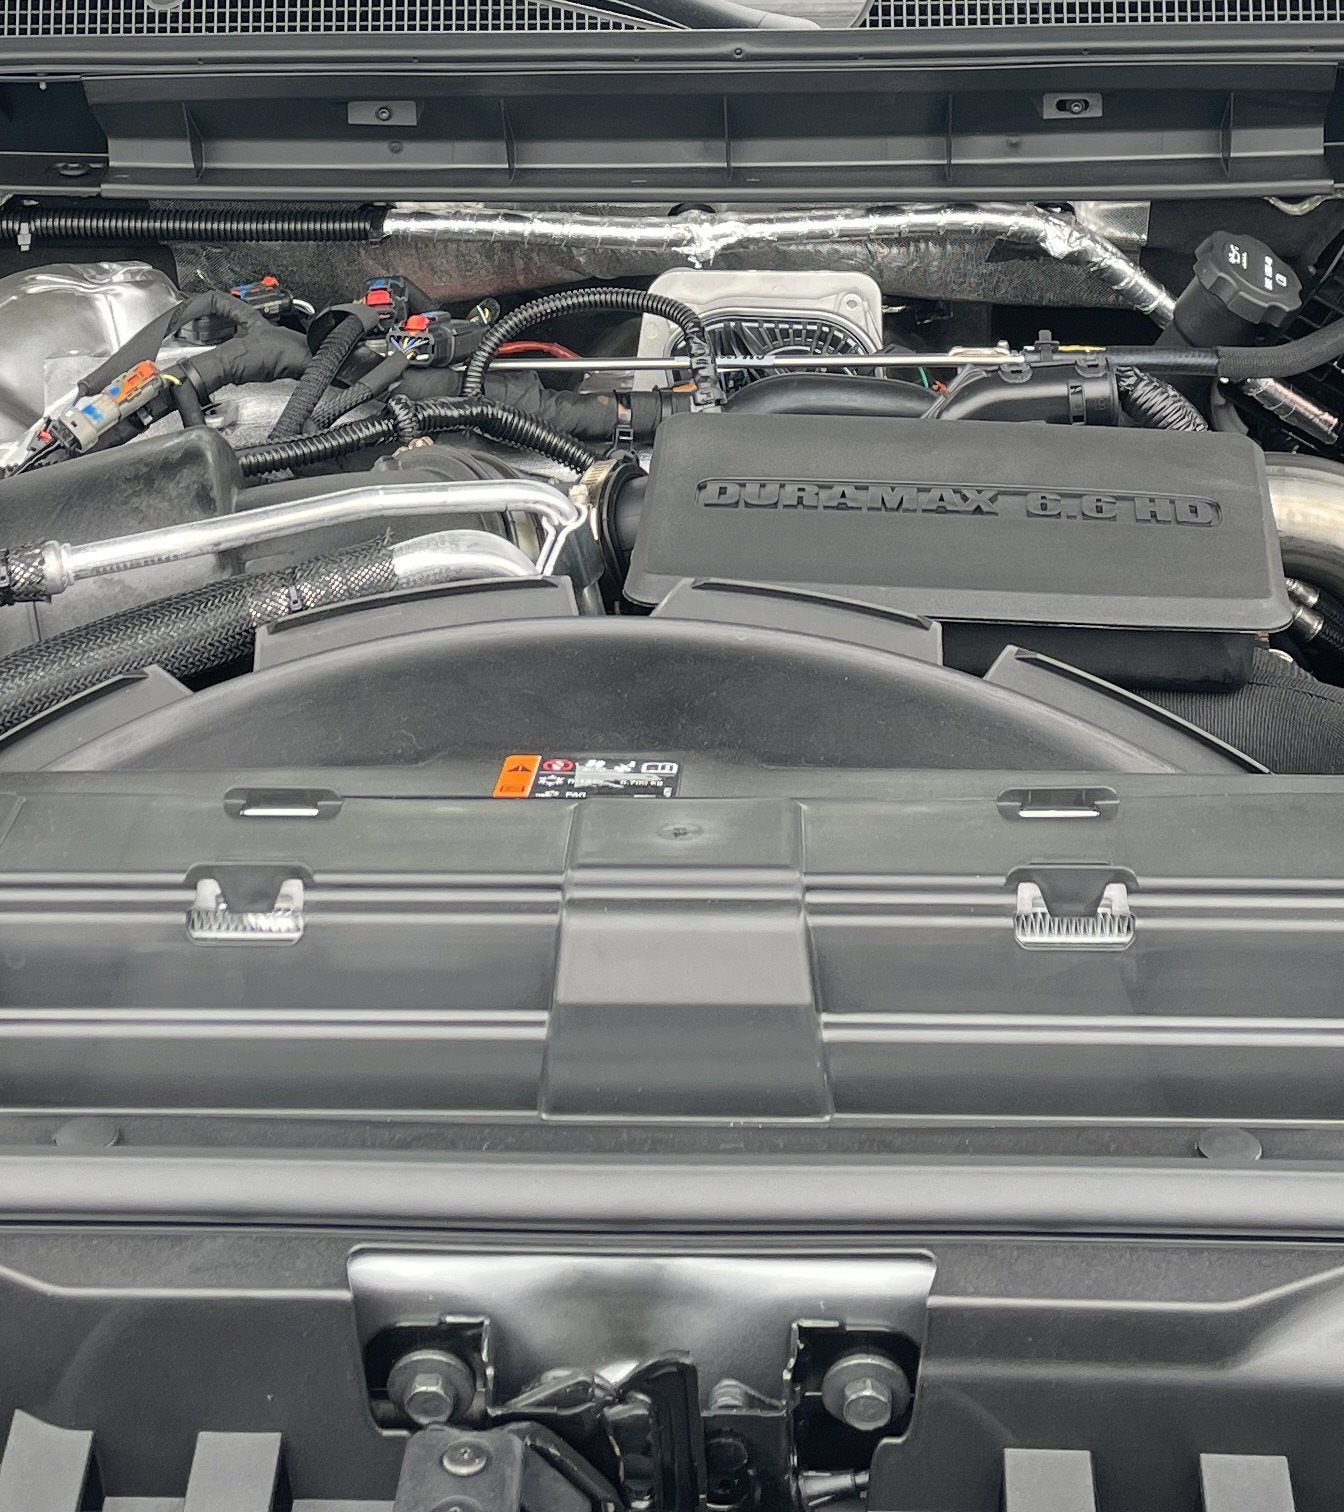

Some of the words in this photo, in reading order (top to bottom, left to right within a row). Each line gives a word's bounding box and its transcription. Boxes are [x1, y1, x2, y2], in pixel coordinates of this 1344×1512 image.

[703, 482, 999, 516] DURAMAX
[1025, 492, 1117, 521] 6.6
[1133, 496, 1218, 526] HD
